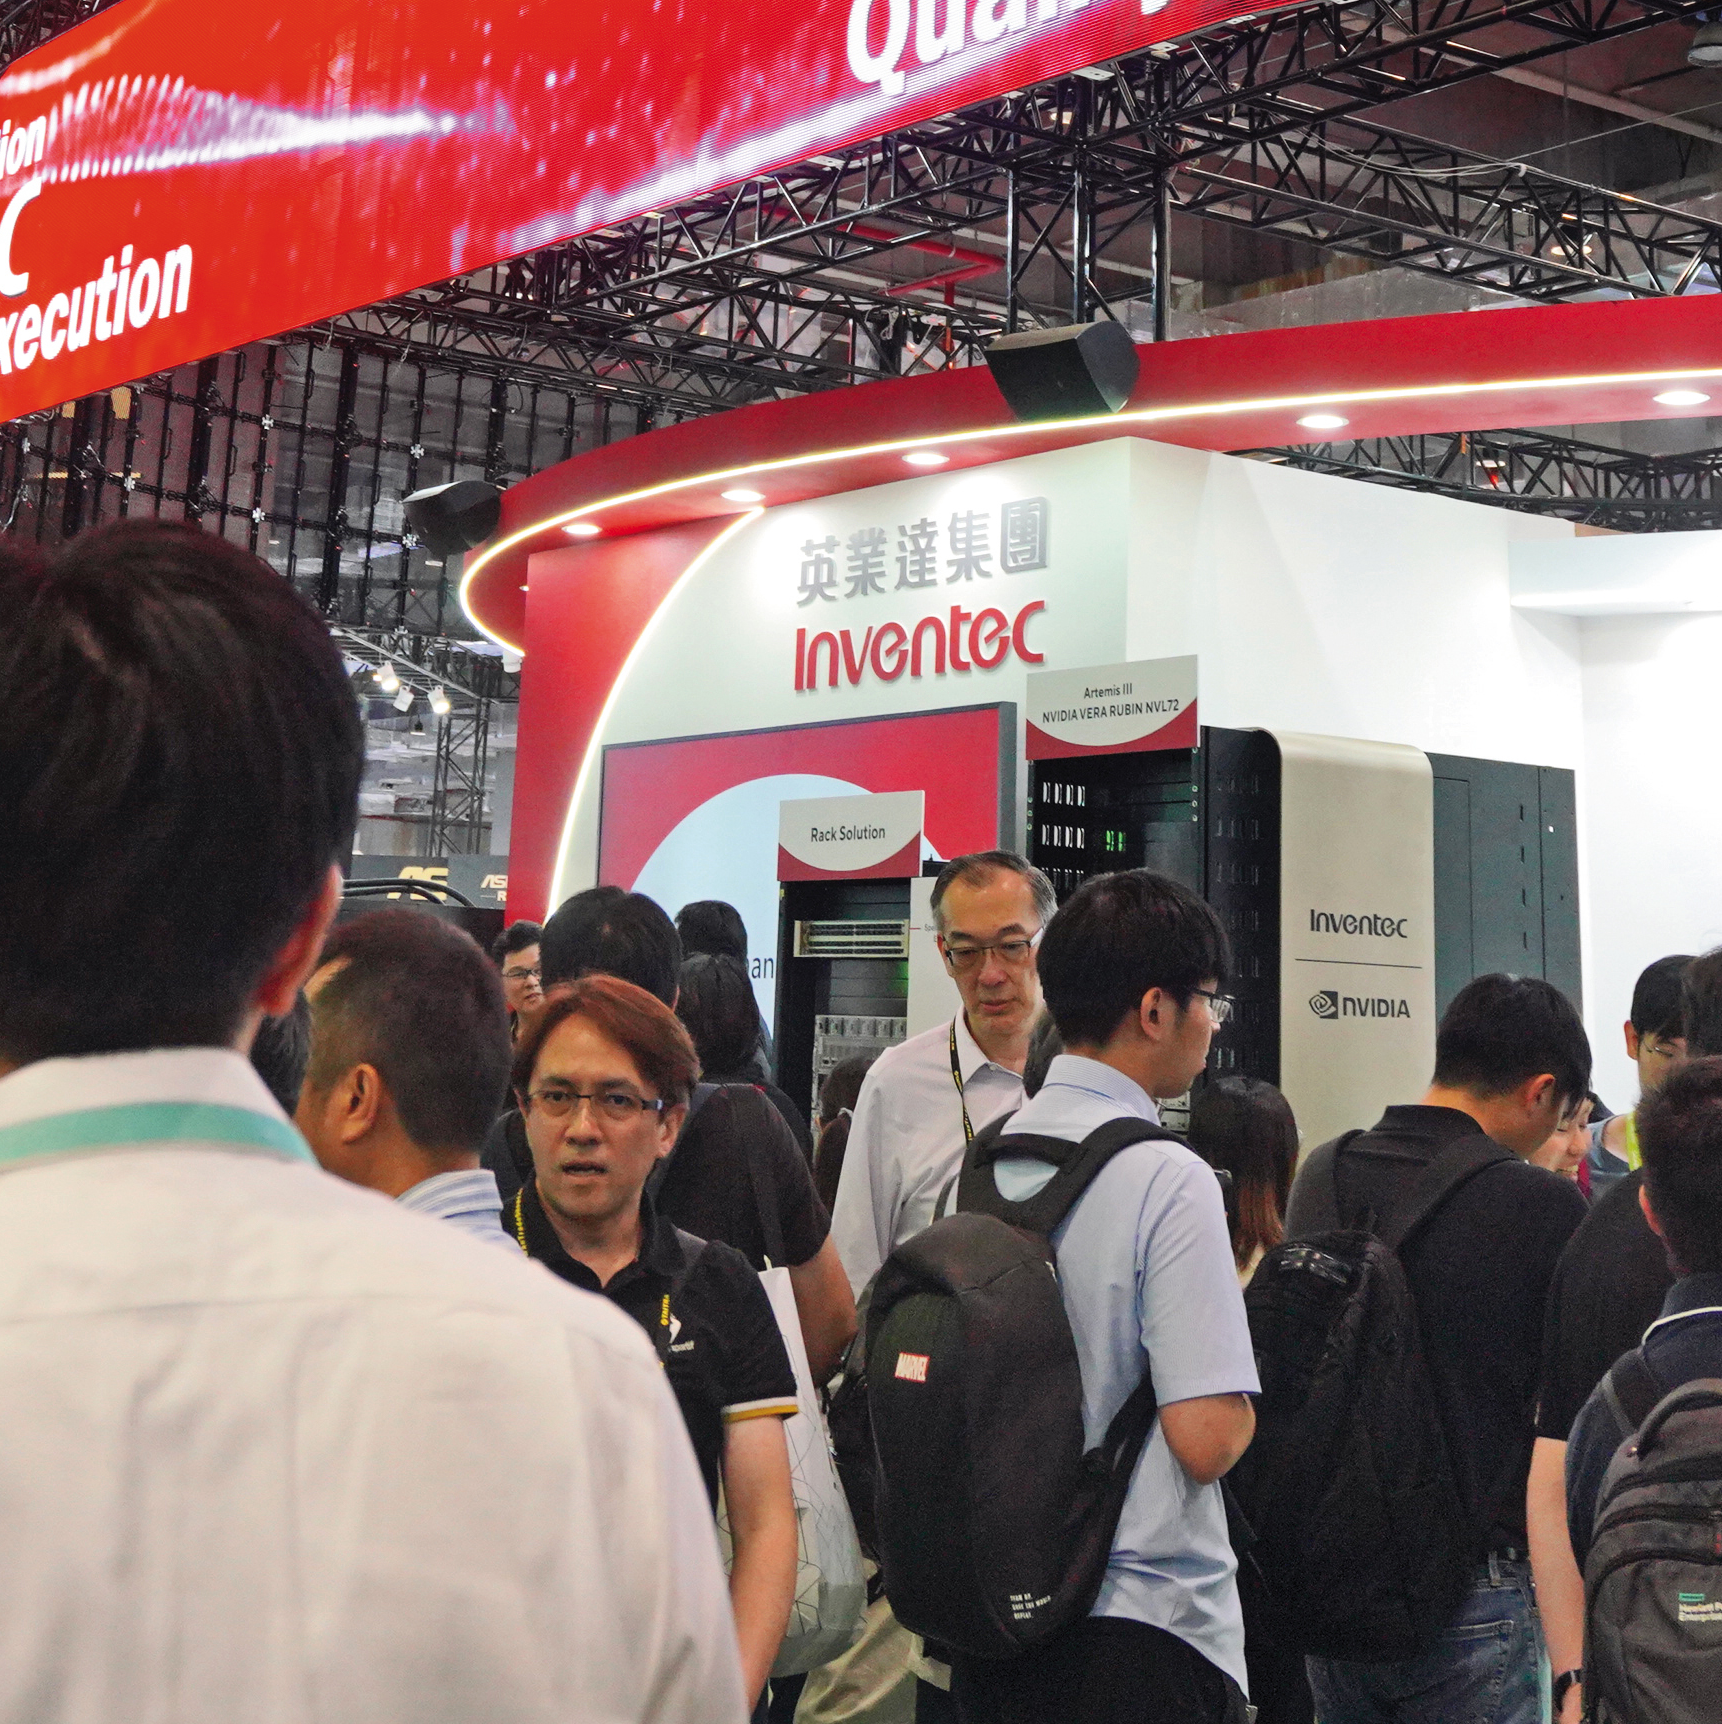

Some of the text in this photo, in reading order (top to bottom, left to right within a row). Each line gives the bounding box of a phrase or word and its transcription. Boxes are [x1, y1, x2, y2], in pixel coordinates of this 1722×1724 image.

[796, 495, 1050, 606] 英業達集團
[794, 599, 1046, 692] Inventec
[1083, 684, 1121, 700] Artemis
[1042, 699, 1180, 723] NVIDIA VERA RUBIN NVL72
[811, 824, 886, 842] Rack Solution
[1309, 908, 1408, 939] Inventec
[1342, 996, 1411, 1019] NVIDIA
